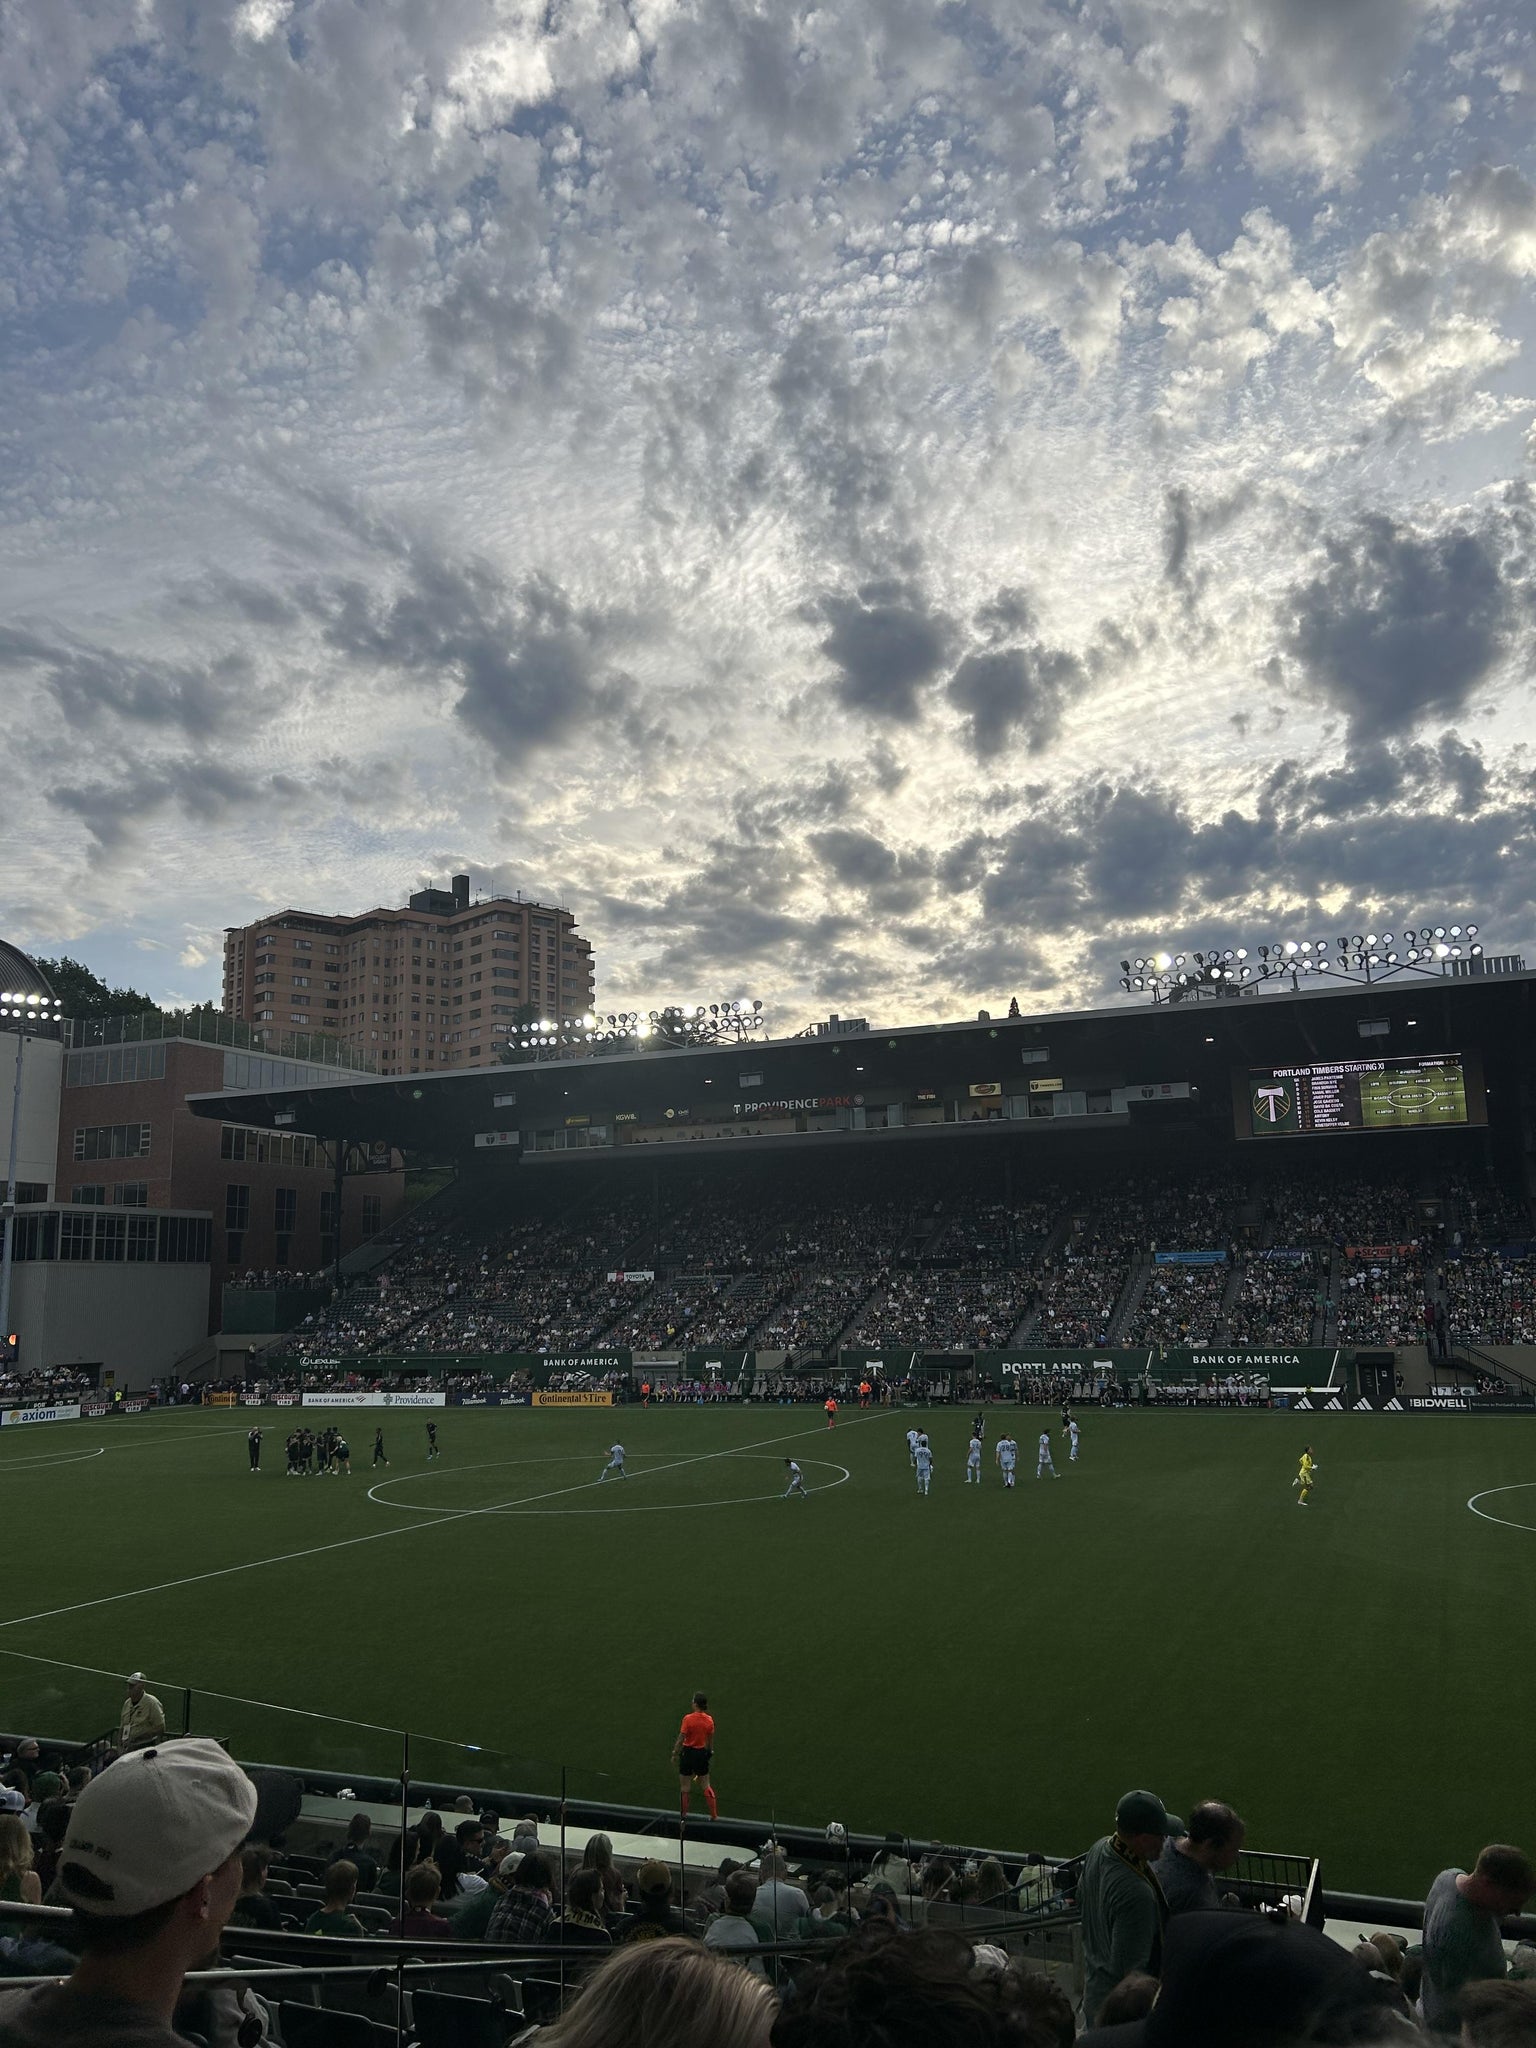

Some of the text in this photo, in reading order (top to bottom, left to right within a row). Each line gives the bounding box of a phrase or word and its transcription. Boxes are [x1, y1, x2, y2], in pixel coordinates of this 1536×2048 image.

[1273, 1063, 1384, 1077] PORTLAND TIMBERS STARTING XI
[744, 1096, 851, 1113] PROVIDENCE PARK
[544, 1359, 566, 1367] BANK
[581, 1358, 619, 1366] AMERICA
[1193, 1355, 1300, 1364] BANK OF AMERICA
[1002, 1362, 1083, 1375] PORTLAND
[271, 1393, 300, 1401] DISCOUNT
[395, 1394, 435, 1405] Providence
[539, 1394, 607, 1405] Continental Tire
[82, 1403, 113, 1412] DISCOUNT
[119, 1400, 148, 1408] DISCOUNT
[1413, 1398, 1468, 1408] BIDWELL
[22, 1410, 56, 1422] axiom
